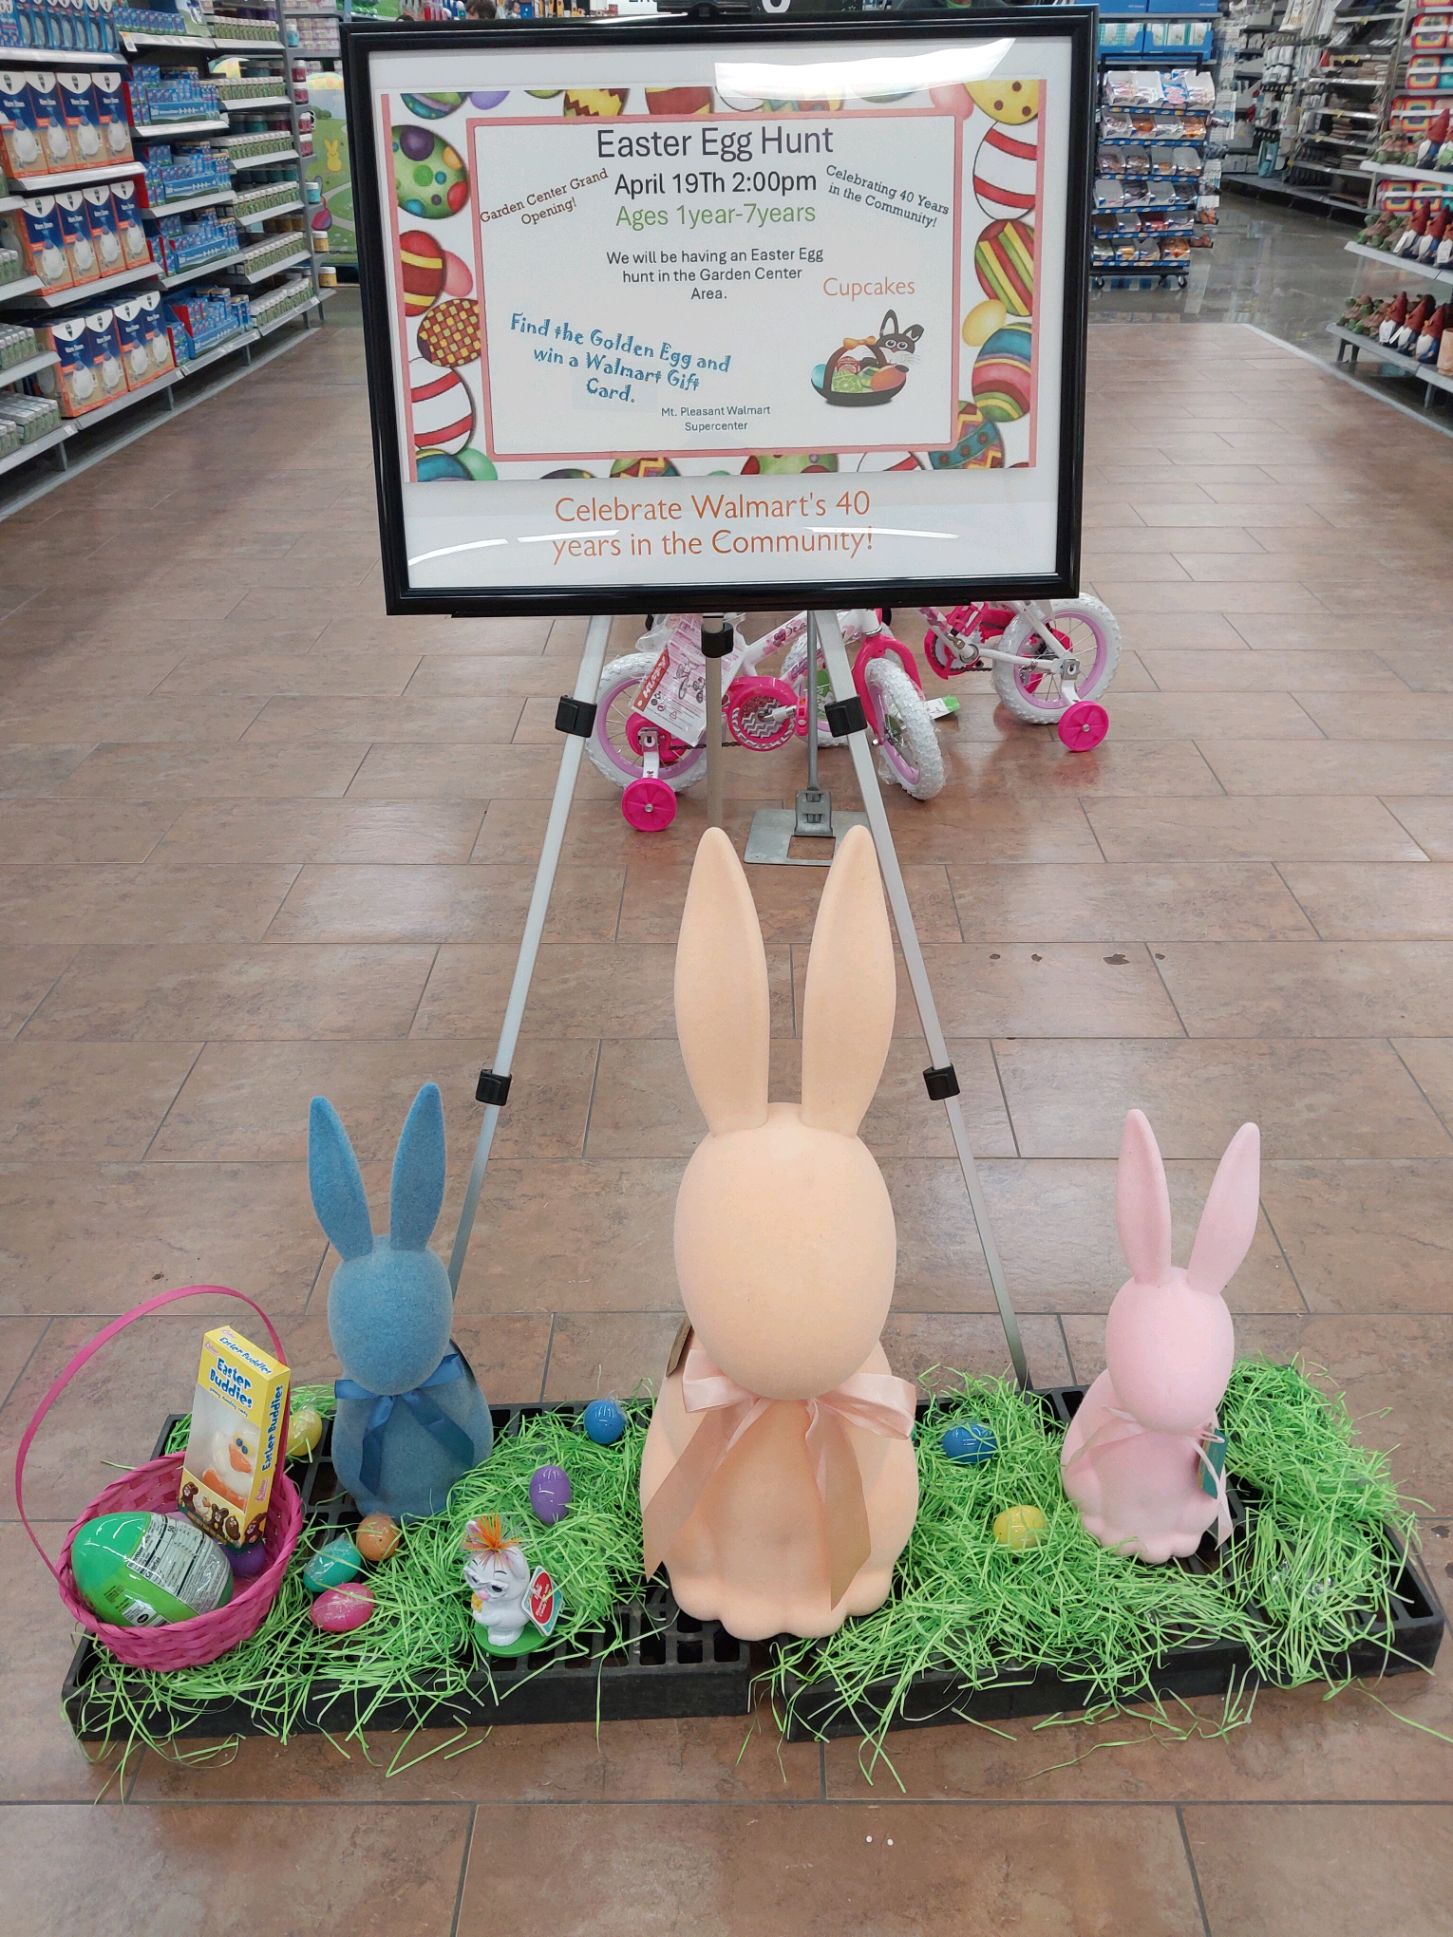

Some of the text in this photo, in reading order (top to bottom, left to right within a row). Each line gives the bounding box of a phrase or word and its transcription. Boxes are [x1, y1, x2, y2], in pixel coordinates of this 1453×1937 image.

[597, 126, 834, 162] Easter Egg Hunt
[480, 168, 609, 223] Garden Center Grand
[614, 171, 817, 200] April 19Th 2:00pm
[825, 164, 950, 216] Celebrating 40 Years
[520, 196, 578, 227] Opening!
[615, 203, 816, 231] Ages 1year-7years
[828, 183, 938, 229] in the Community!
[606, 247, 824, 265] We will be having an Easter Egg
[622, 266, 803, 284] hunt in the Garden Center
[822, 277, 916, 300] Cupcakes
[690, 287, 728, 300] Area.
[510, 312, 732, 373] Find the Golden Egg and
[533, 347, 700, 392] win a Walmart Gift
[586, 378, 635, 403] Card.
[661, 405, 771, 417] Mt. Pleasant Walmart
[684, 421, 748, 433] Supercenter
[555, 490, 870, 523] Celebrate Walmart's 40
[552, 526, 873, 566] years in the Community!
[220, 1337, 243, 1354] Easter
[242, 1353, 272, 1375] Buddies
[209, 1369, 253, 1408] Buddies
[217, 1358, 251, 1389] Easter
[267, 1385, 283, 1433] Buddies
[262, 1434, 276, 1471] Easter
